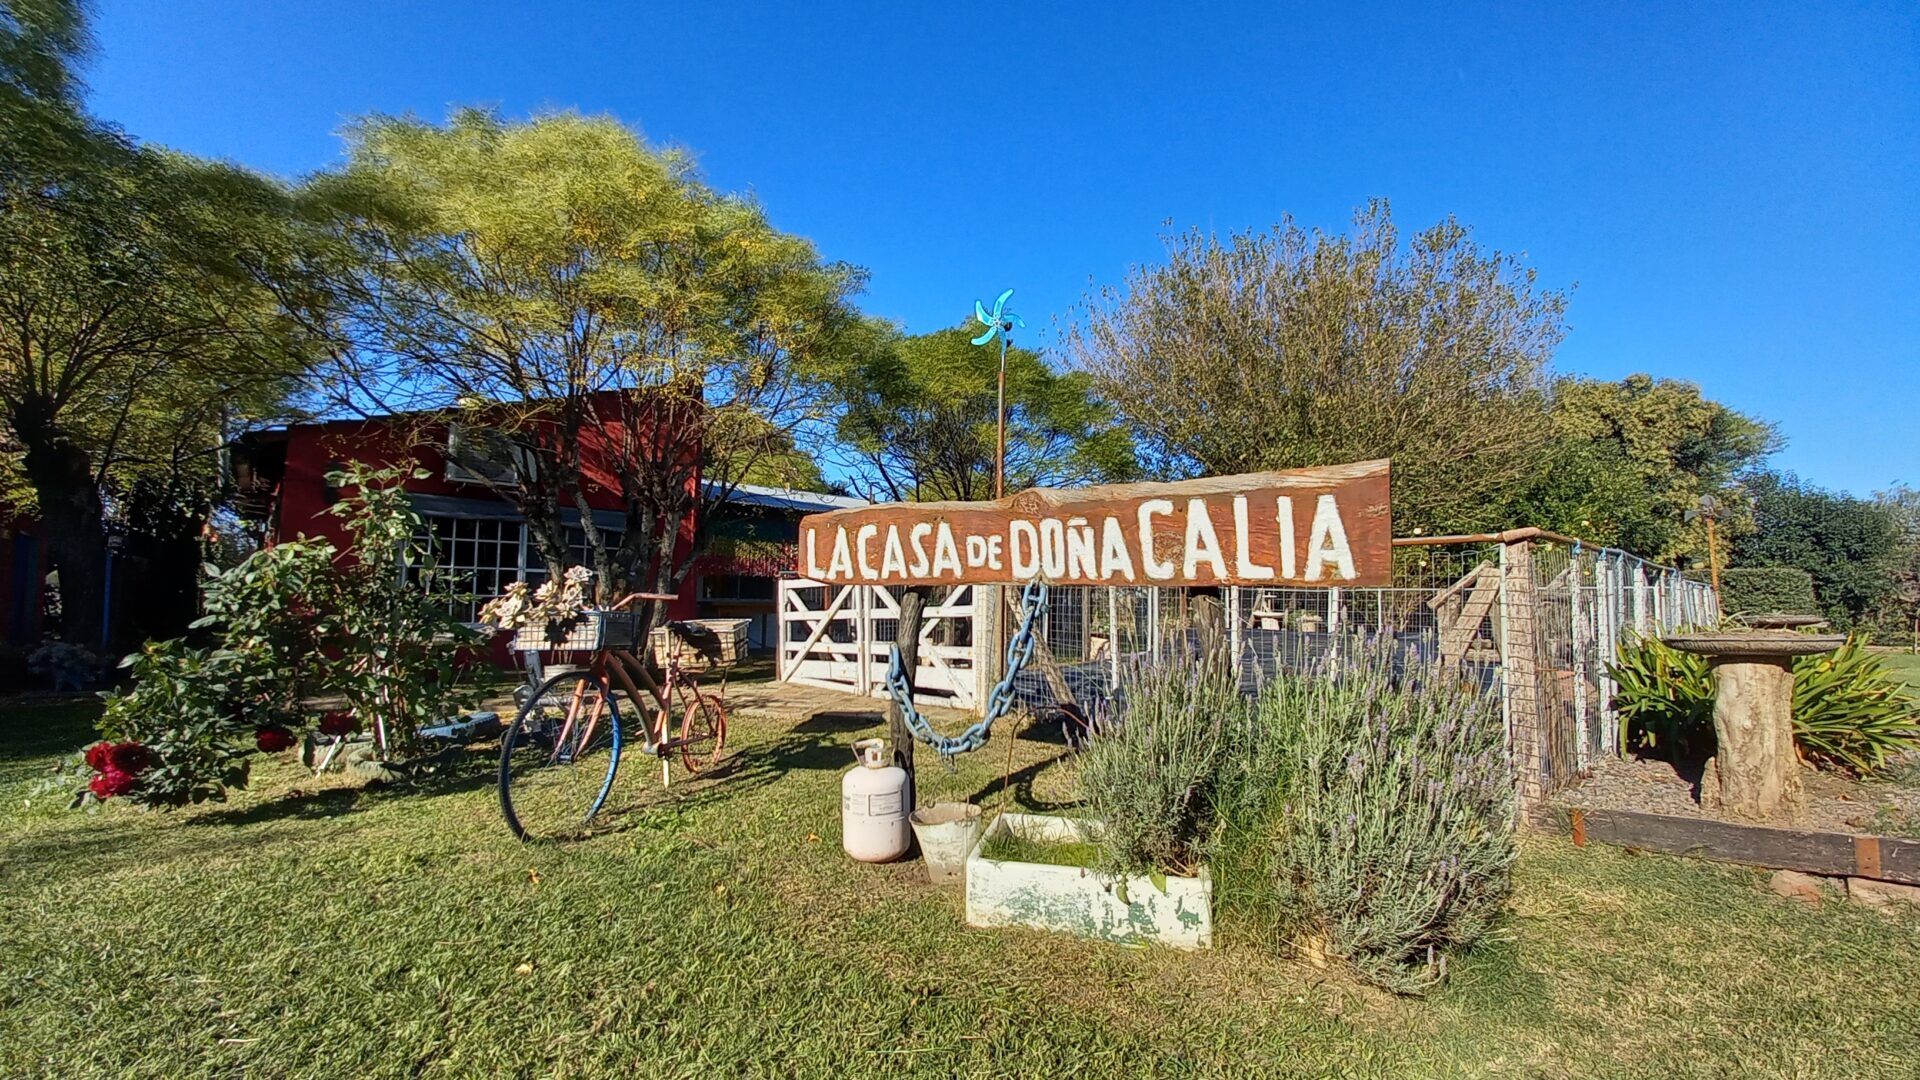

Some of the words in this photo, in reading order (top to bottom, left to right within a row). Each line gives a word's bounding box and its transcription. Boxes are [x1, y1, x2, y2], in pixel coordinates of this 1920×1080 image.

[806, 525, 854, 580] LA
[856, 522, 963, 580] CASA
[966, 535, 1003, 571] DE
[1009, 517, 1135, 582] DOÑA
[1137, 494, 1357, 581] CALIA
